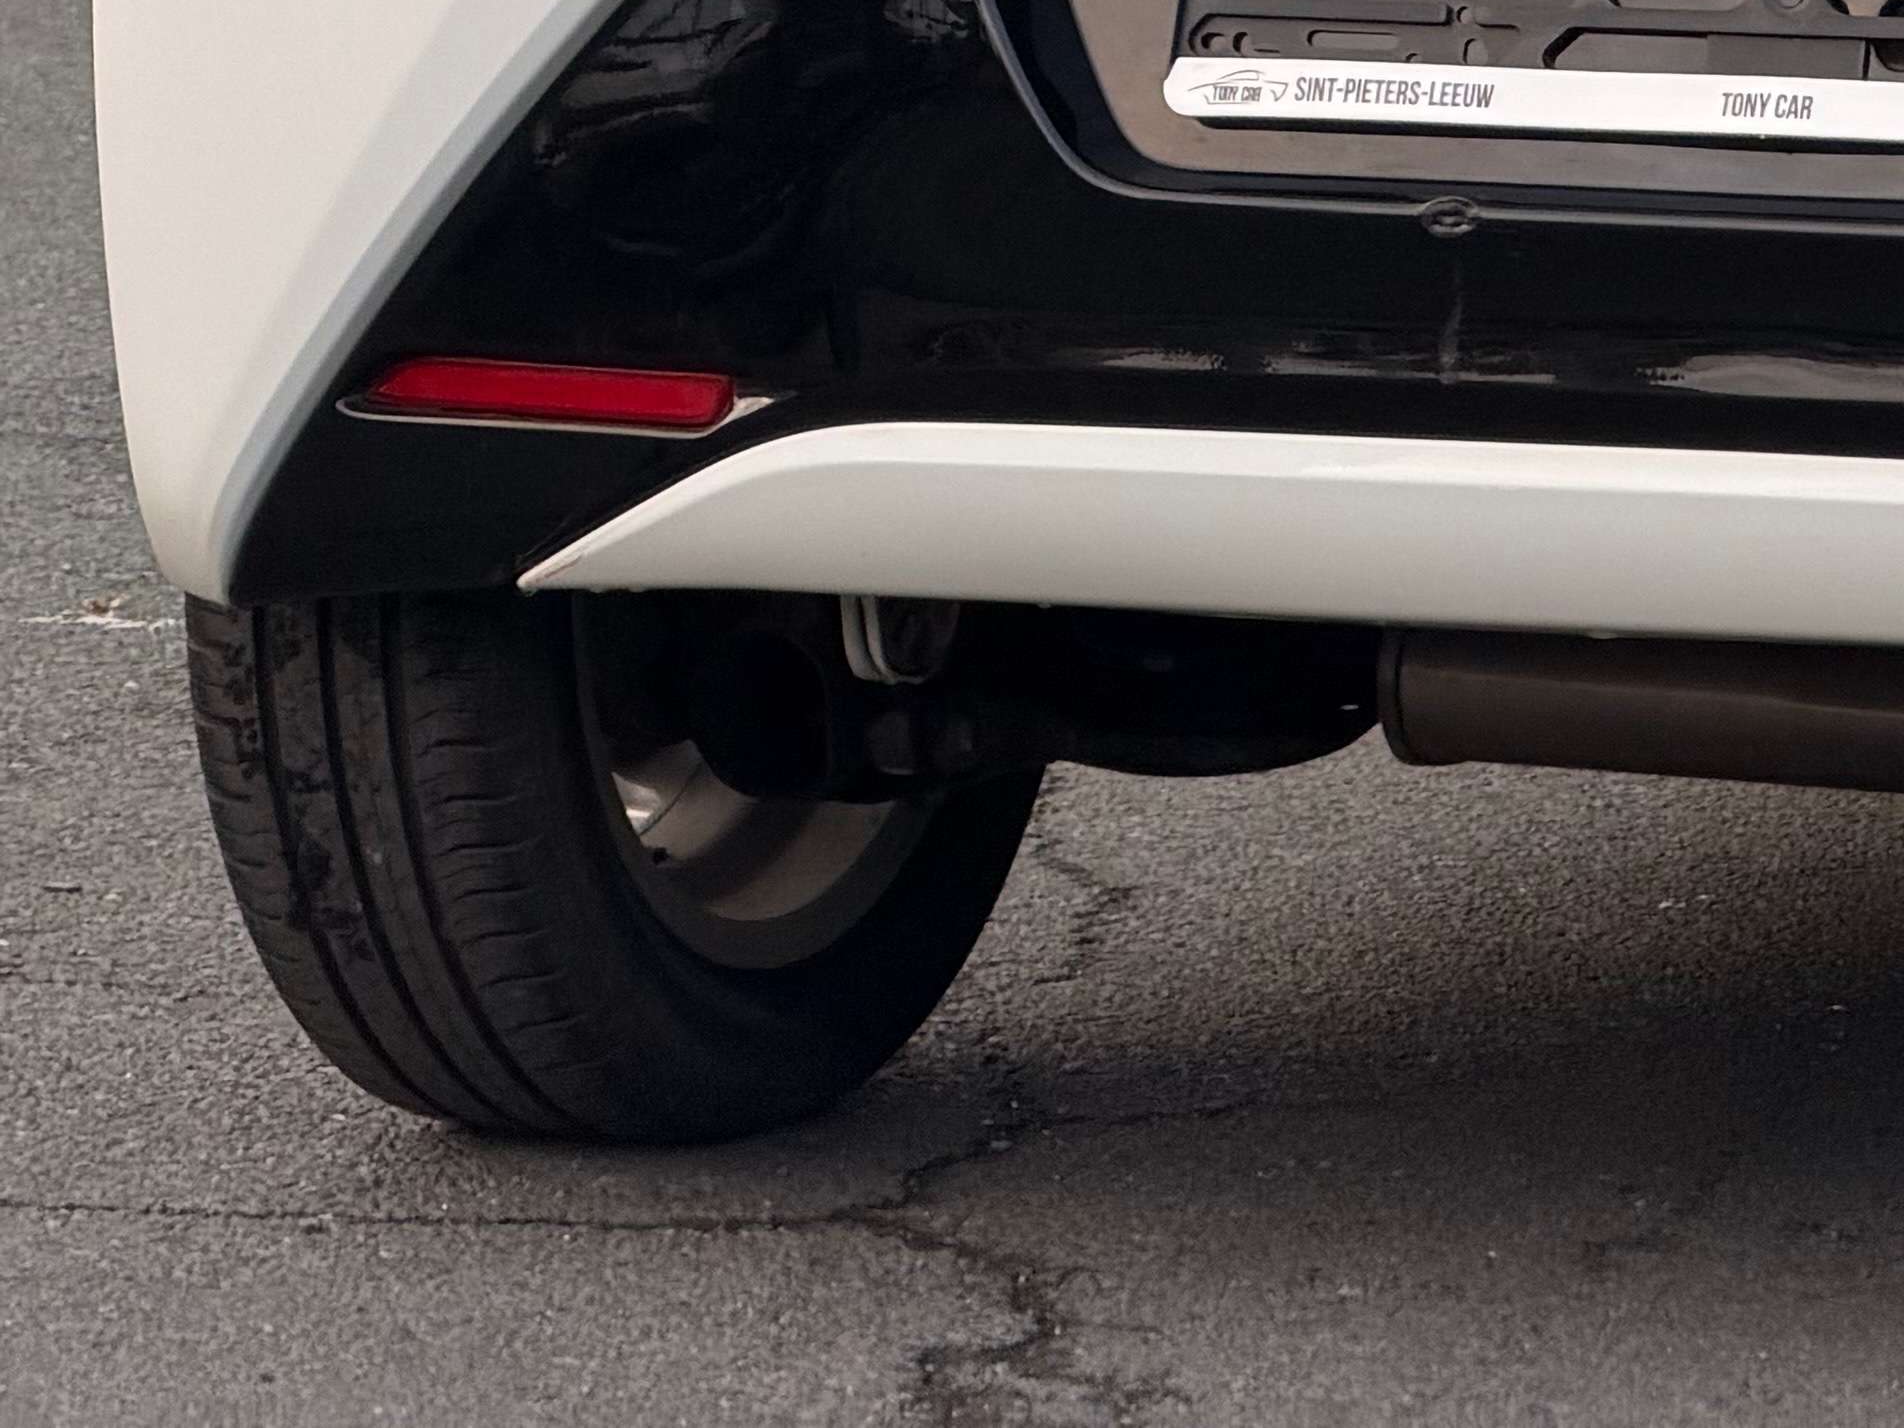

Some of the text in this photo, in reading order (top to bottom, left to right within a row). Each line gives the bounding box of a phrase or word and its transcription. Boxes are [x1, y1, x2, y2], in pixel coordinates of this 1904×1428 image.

[1293, 76, 1495, 109] SINT-PIETERS-LEEUW
[1721, 92, 1814, 120] TONY CAR
